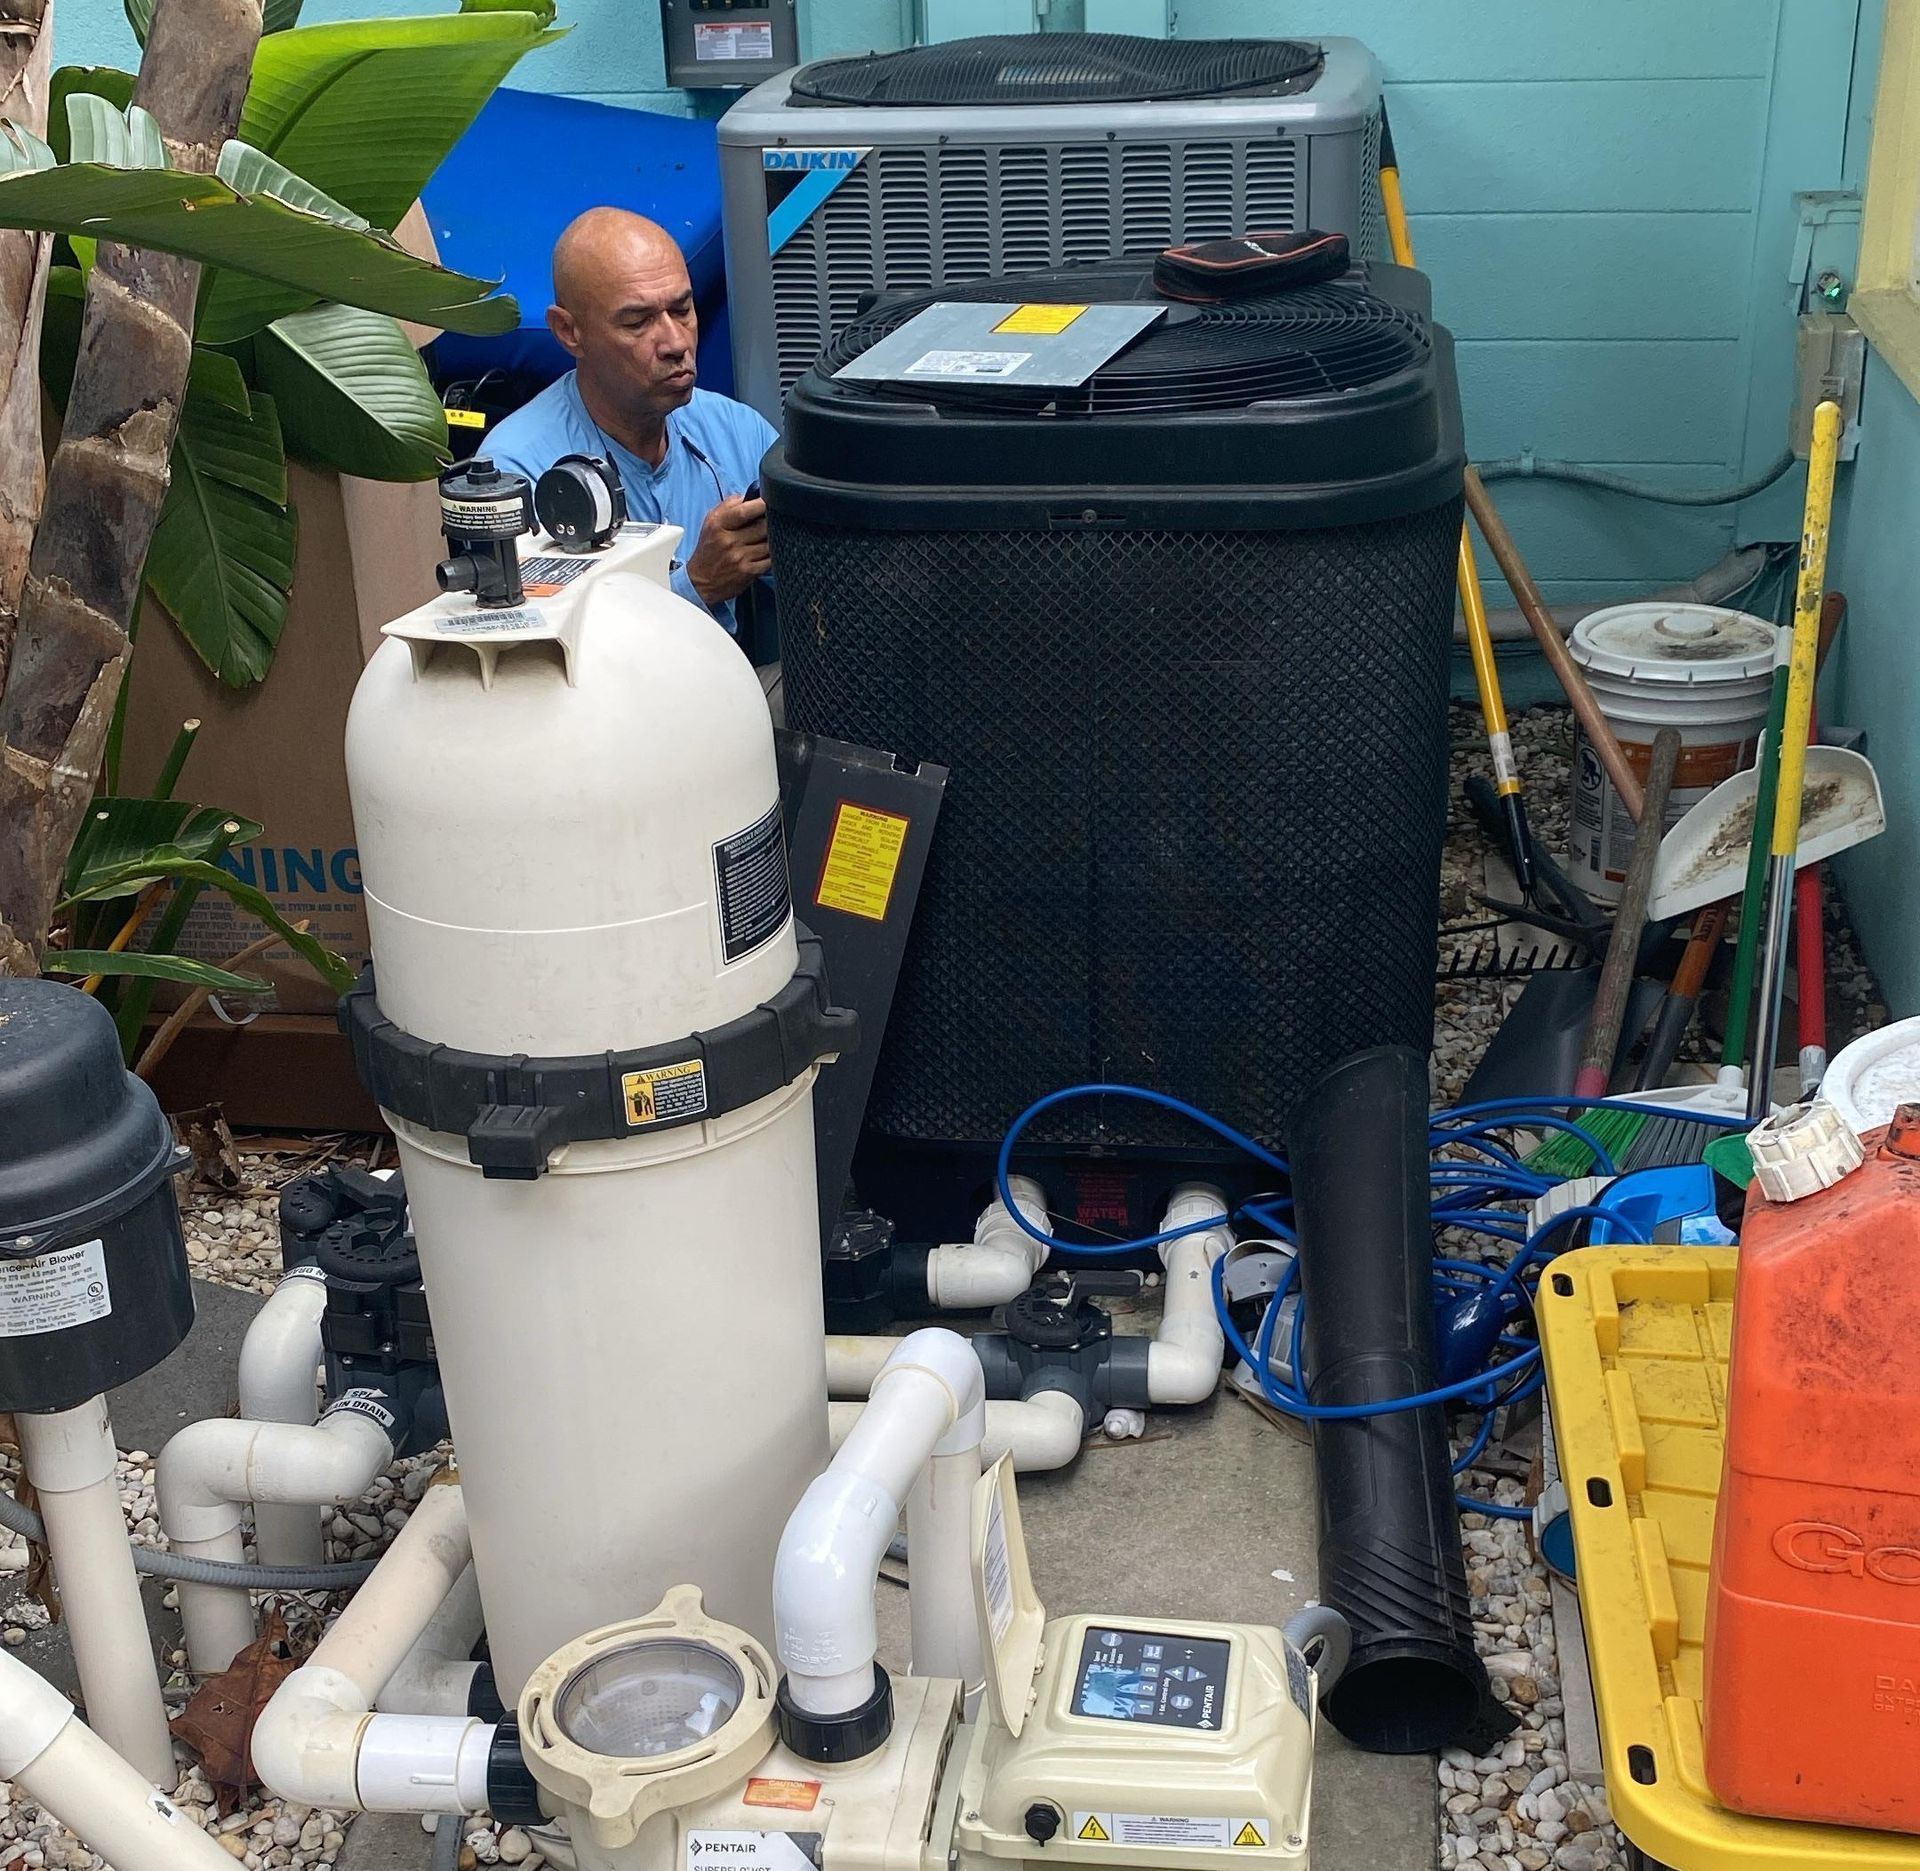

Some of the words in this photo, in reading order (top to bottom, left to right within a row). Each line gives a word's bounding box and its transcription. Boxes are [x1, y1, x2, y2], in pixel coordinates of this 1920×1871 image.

[764, 152, 857, 169] DAIKIN
[459, 505, 497, 513] WARNING
[173, 847, 363, 894] NING
[646, 1065, 691, 1081] WARNING
[1078, 1207, 1127, 1218] WATER
[0, 1260, 46, 1274] ncer-Air
[49, 1250, 86, 1266] Blower
[11, 1289, 61, 1303] WARNING
[352, 1400, 388, 1421] DRAIN
[1163, 1677, 1171, 1688] Only
[1160, 1688, 1168, 1704] Control
[1201, 1684, 1214, 1719] PENTAIR
[768, 1780, 806, 1788] CAUTION
[705, 1843, 757, 1853] PENTAIR
